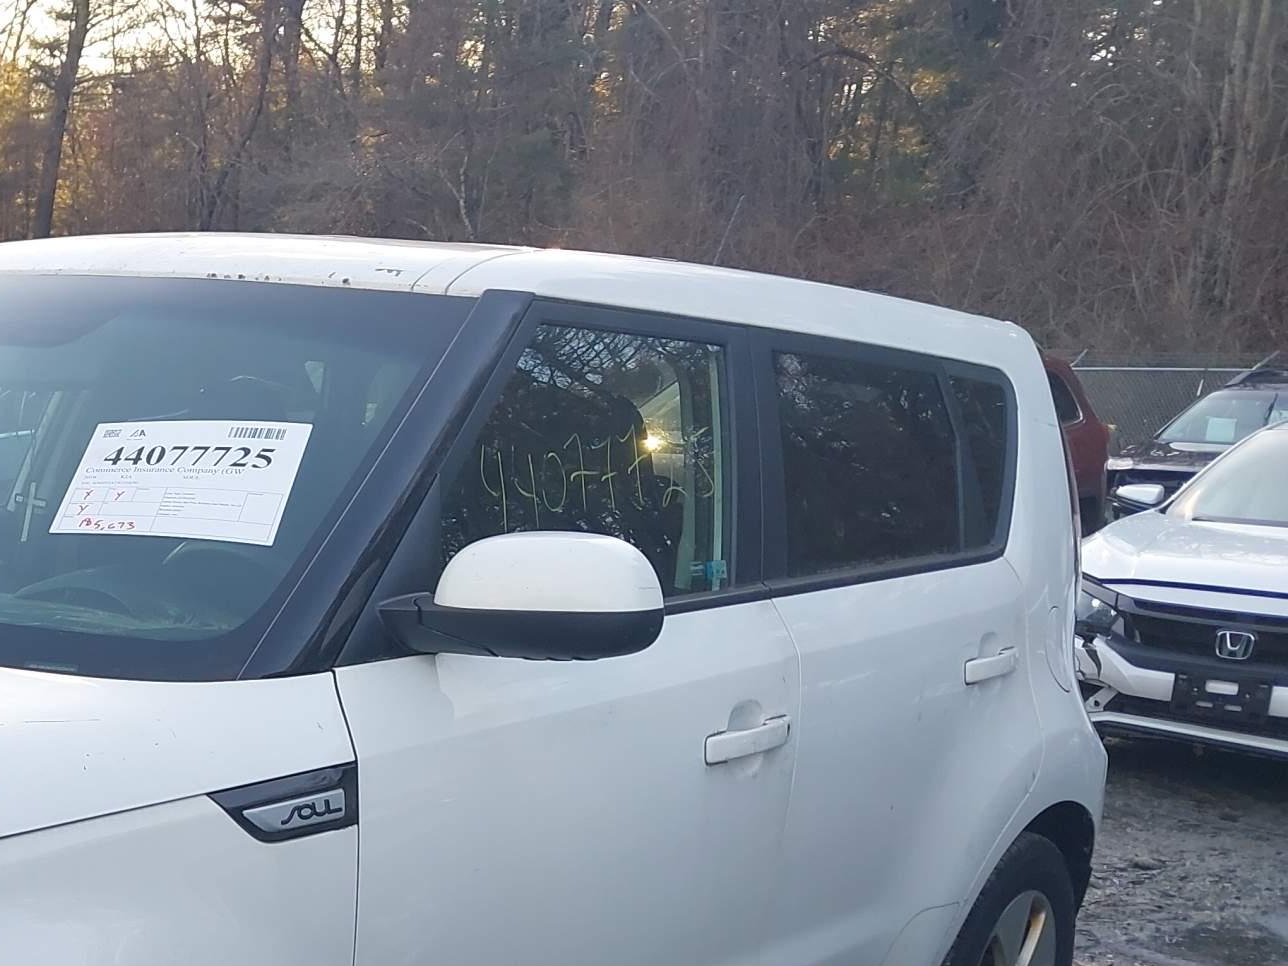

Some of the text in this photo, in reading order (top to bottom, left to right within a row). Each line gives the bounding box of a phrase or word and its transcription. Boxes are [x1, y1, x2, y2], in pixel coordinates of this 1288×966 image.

[104, 445, 276, 469] 44077725
[85, 466, 130, 474] Commerce
[133, 466, 174, 474] Insurance
[177, 466, 220, 476] Company
[280, 799, 343, 826] SOUL
